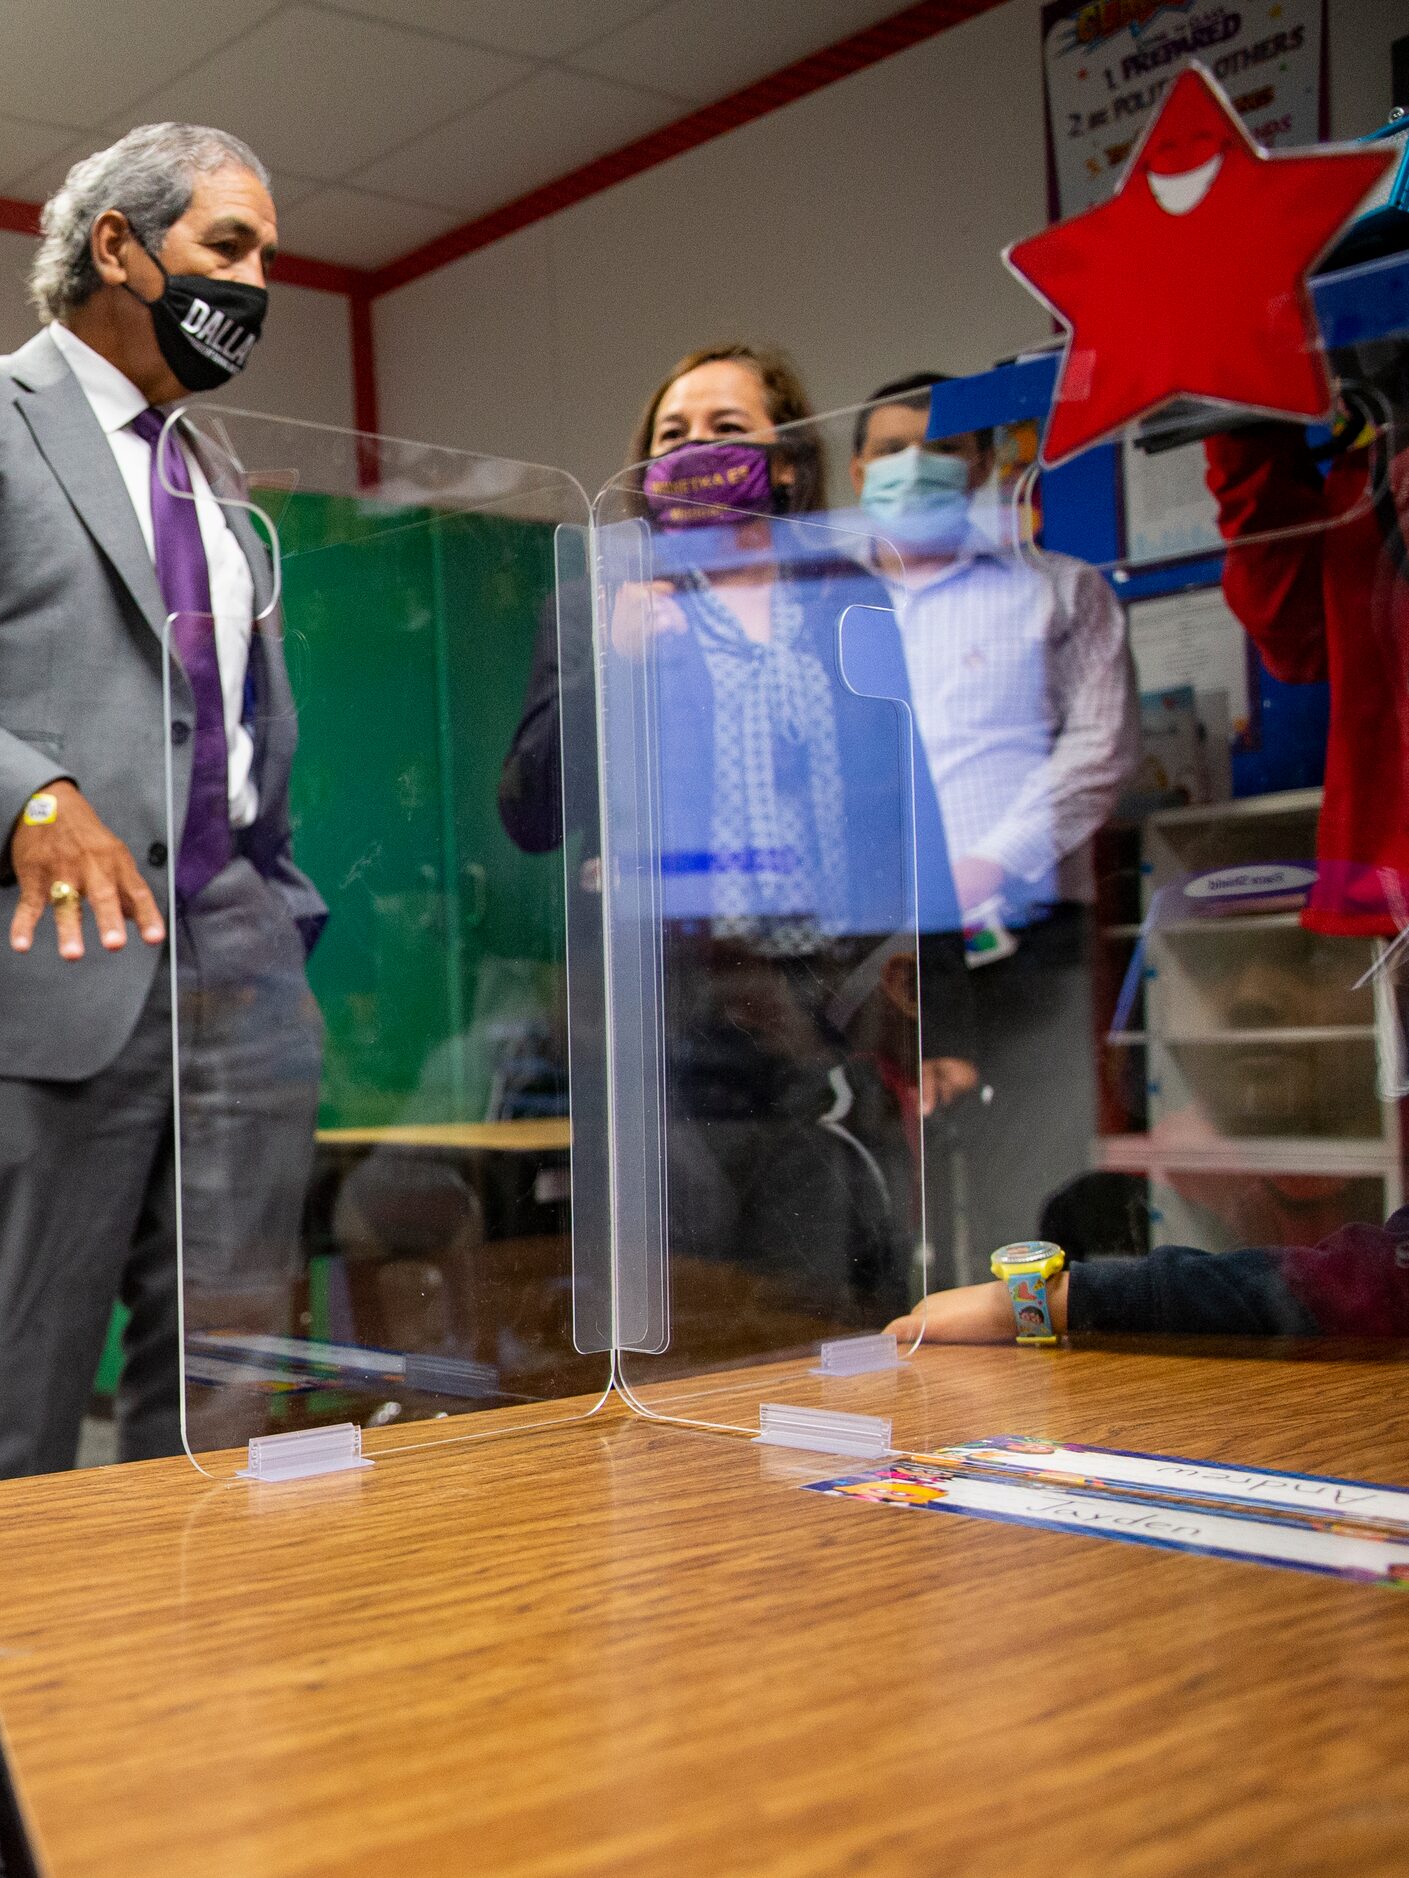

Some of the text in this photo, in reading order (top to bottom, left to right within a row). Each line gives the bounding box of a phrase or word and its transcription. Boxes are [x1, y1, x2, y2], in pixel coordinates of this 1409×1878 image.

[1112, 76, 1167, 119] POLIT
[1213, 25, 1305, 79] OTHERS
[180, 297, 257, 367] DALLA
[1156, 1465, 1378, 1506] Andrew
[1025, 1495, 1203, 1540] Jayden
